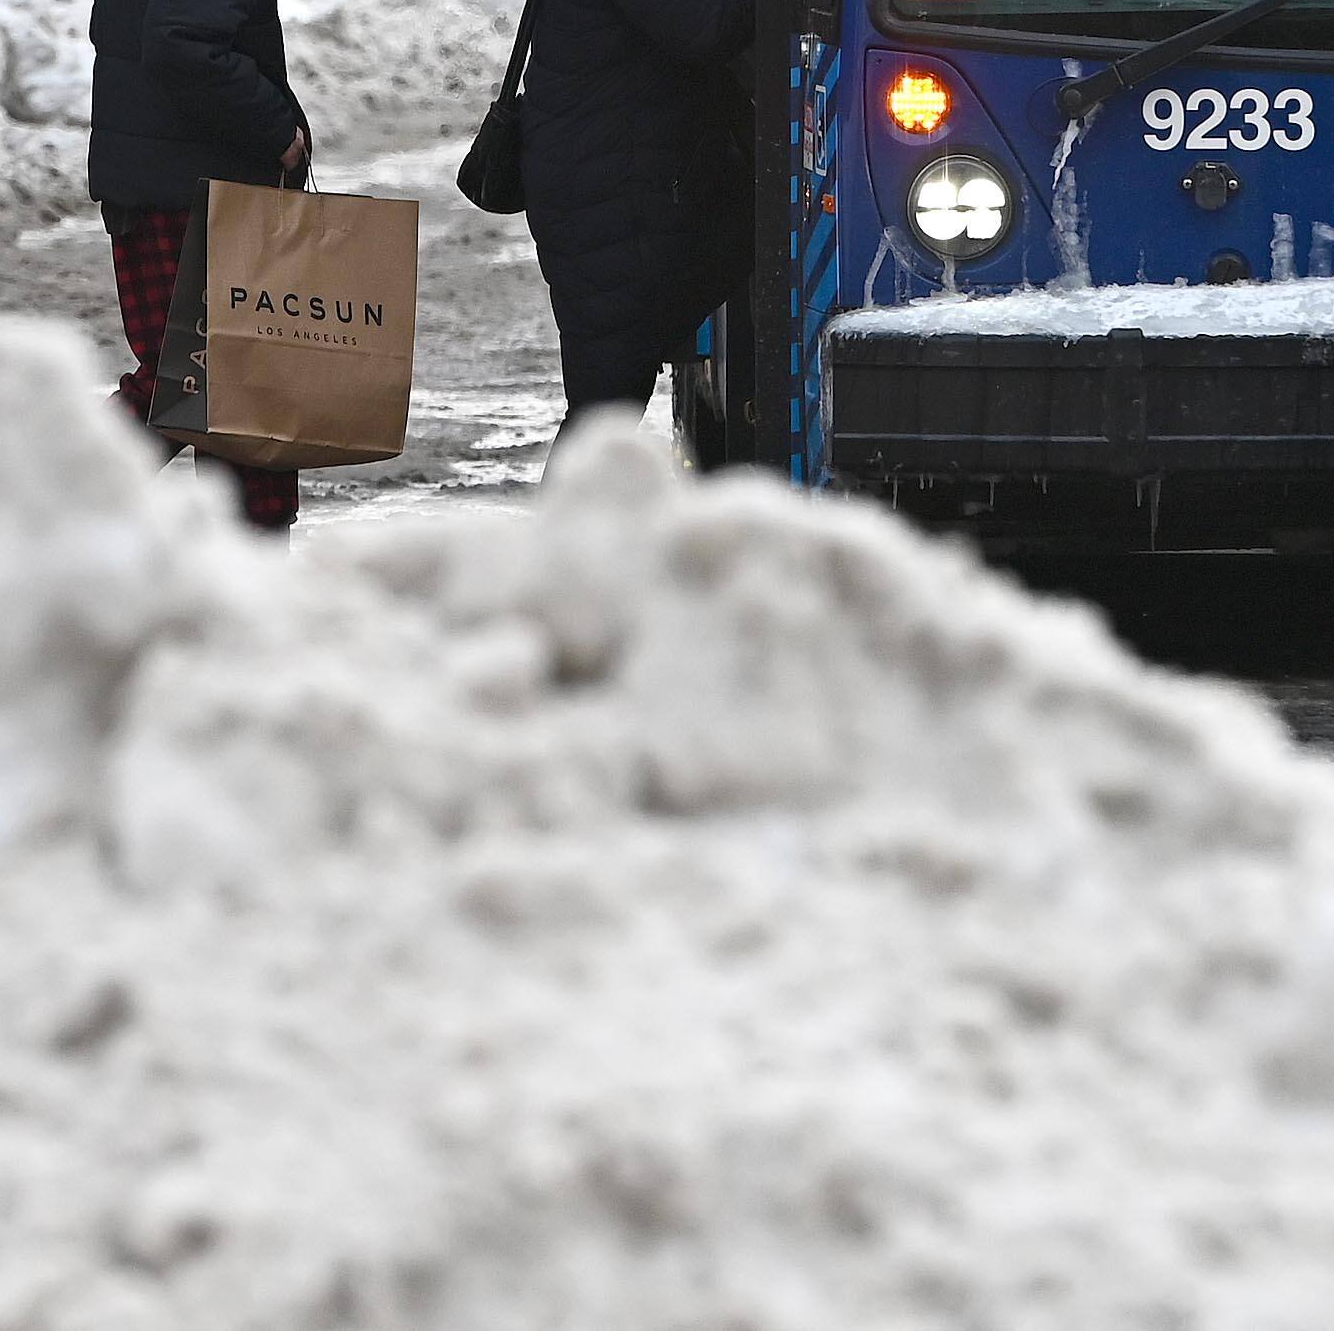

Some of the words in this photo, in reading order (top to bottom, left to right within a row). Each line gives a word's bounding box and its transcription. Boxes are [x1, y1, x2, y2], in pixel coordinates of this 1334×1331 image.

[1141, 88, 1316, 151] 9233
[229, 286, 384, 327] PACSUN
[256, 326, 283, 338] LOS
[293, 330, 359, 347] ANGELES
